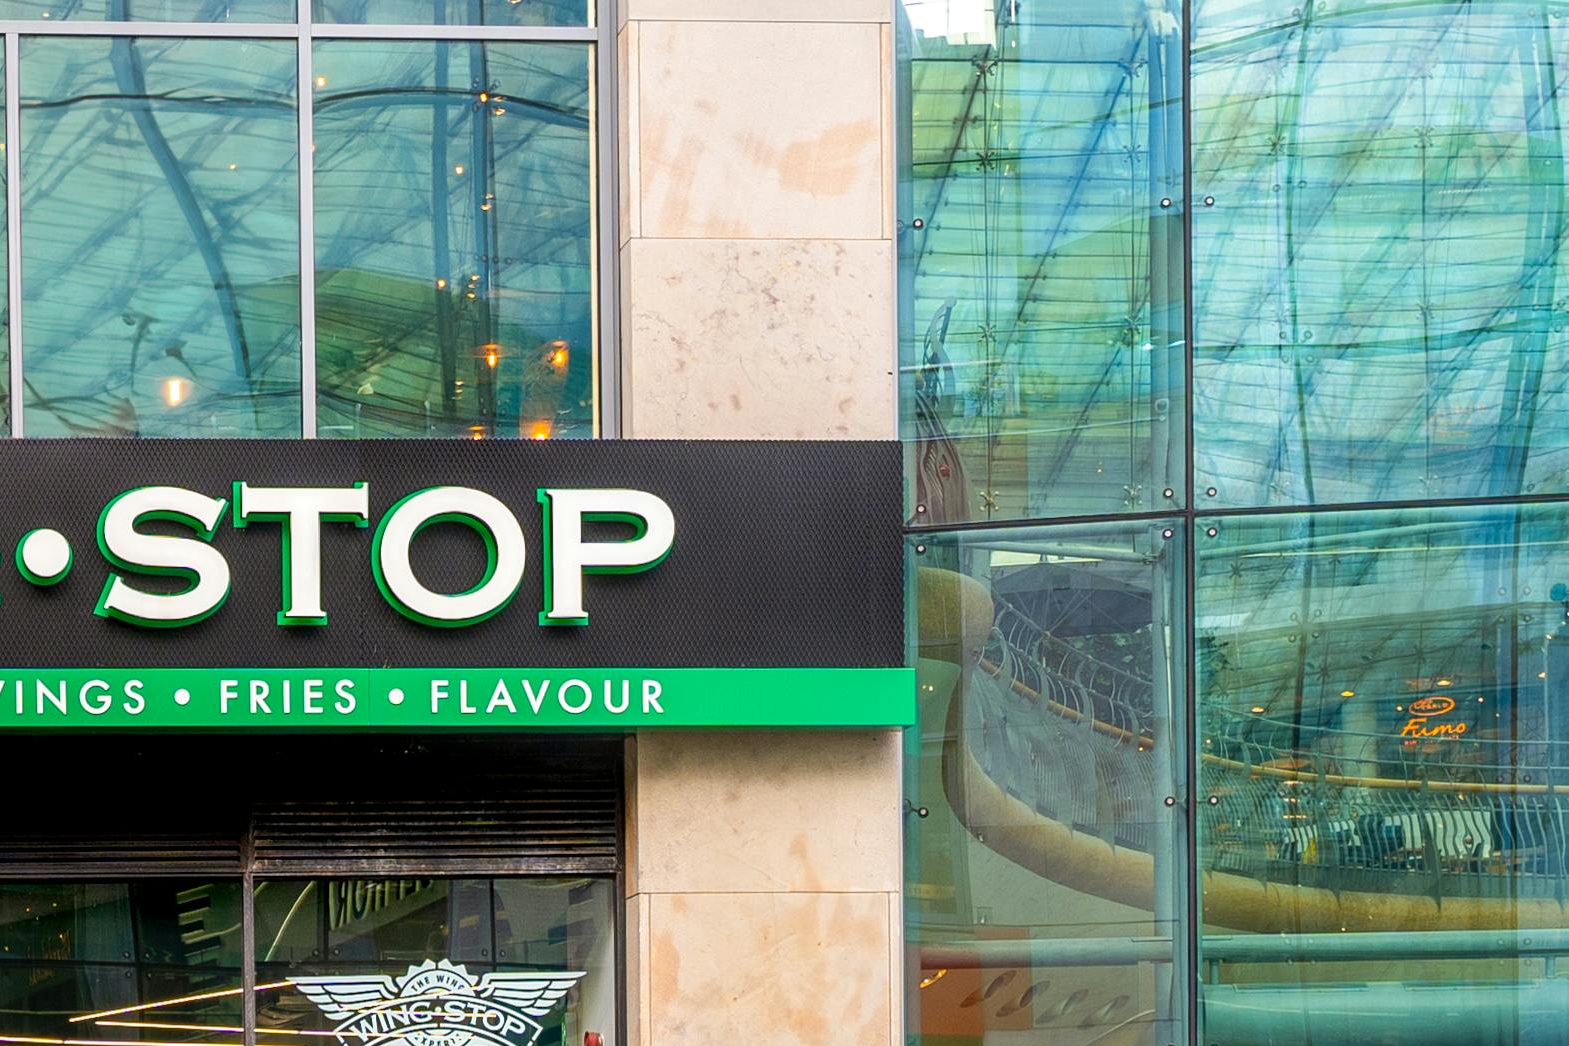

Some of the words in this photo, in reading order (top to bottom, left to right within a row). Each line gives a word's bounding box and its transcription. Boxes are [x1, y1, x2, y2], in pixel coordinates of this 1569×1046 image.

[219, 679, 357, 715] FRIES
[432, 679, 665, 714] FLAVOUR
[1400, 717, 1467, 737] Fumo
[410, 975, 431, 992] THE
